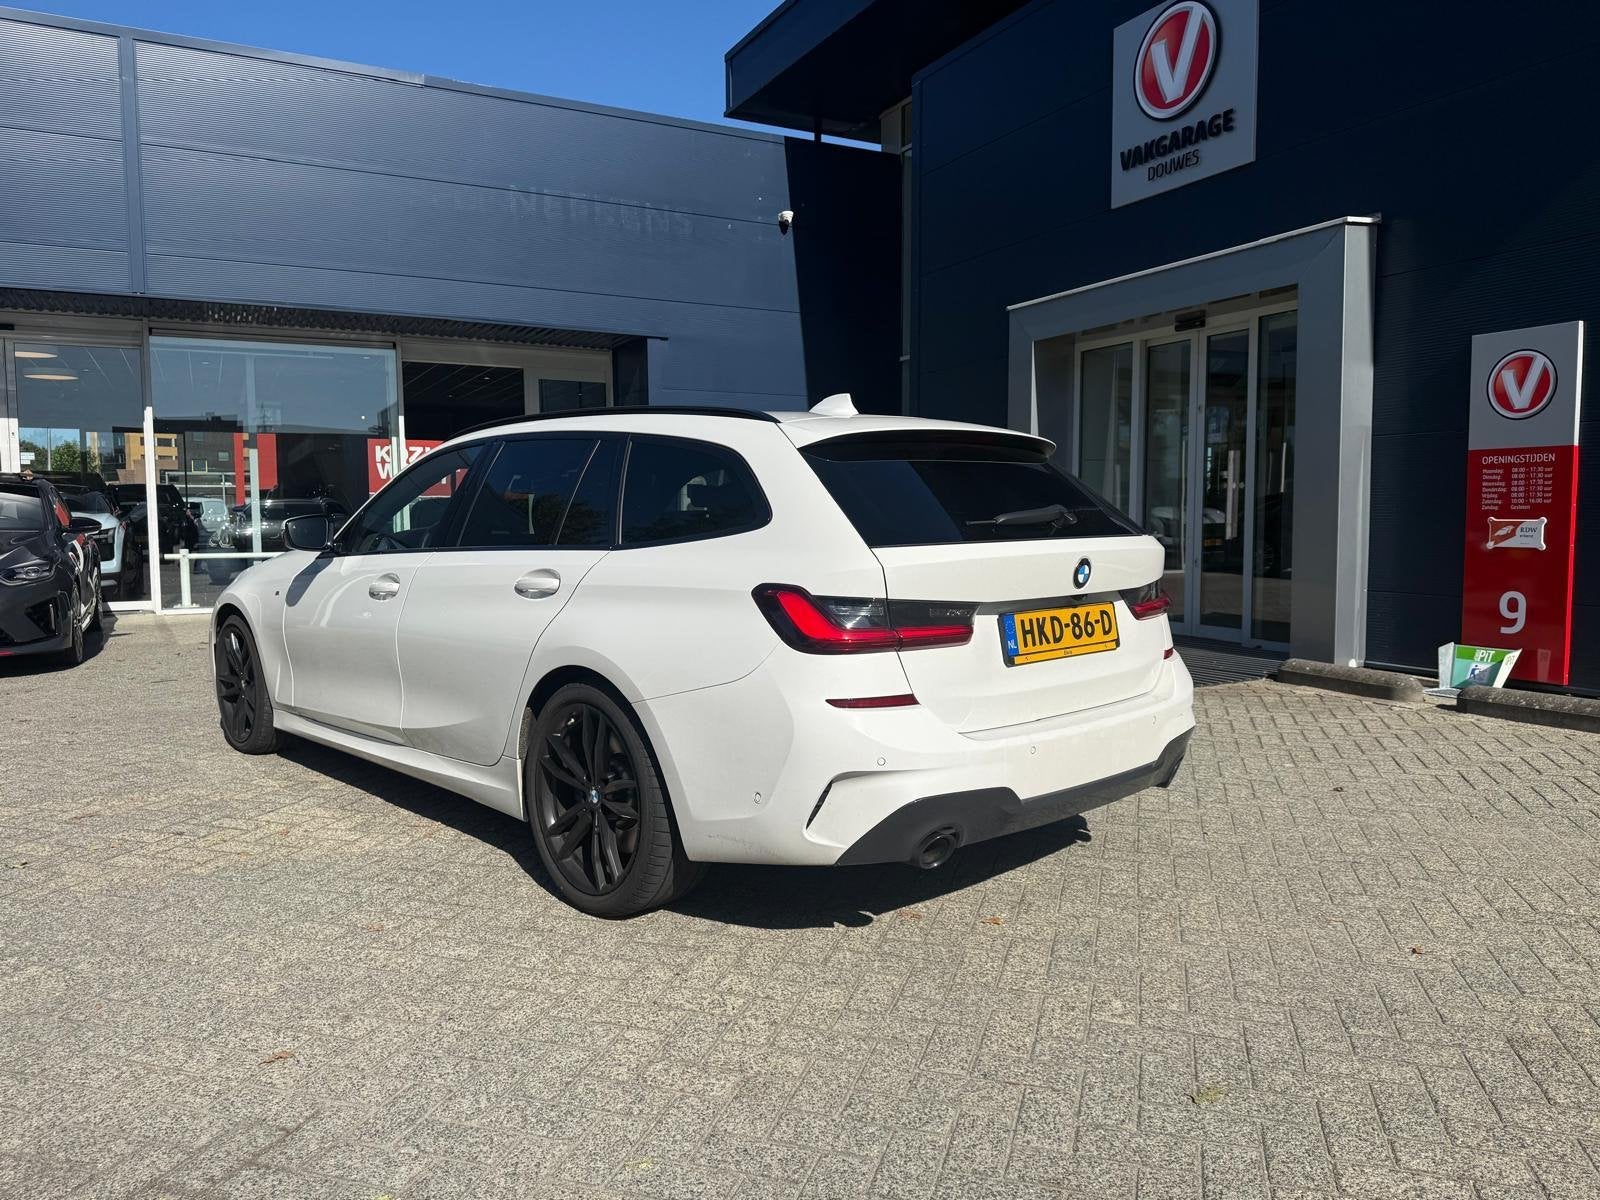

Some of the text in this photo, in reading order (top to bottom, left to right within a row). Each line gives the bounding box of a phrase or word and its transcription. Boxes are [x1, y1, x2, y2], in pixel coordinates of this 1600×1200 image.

[1120, 108, 1234, 171] VAKGARAGE
[1148, 149, 1200, 181] DOUWES
[1482, 453, 1555, 464] OPENINGSTIJDEN
[1008, 610, 1112, 649] NL HKD-86-D
[1499, 591, 1526, 634] 9
